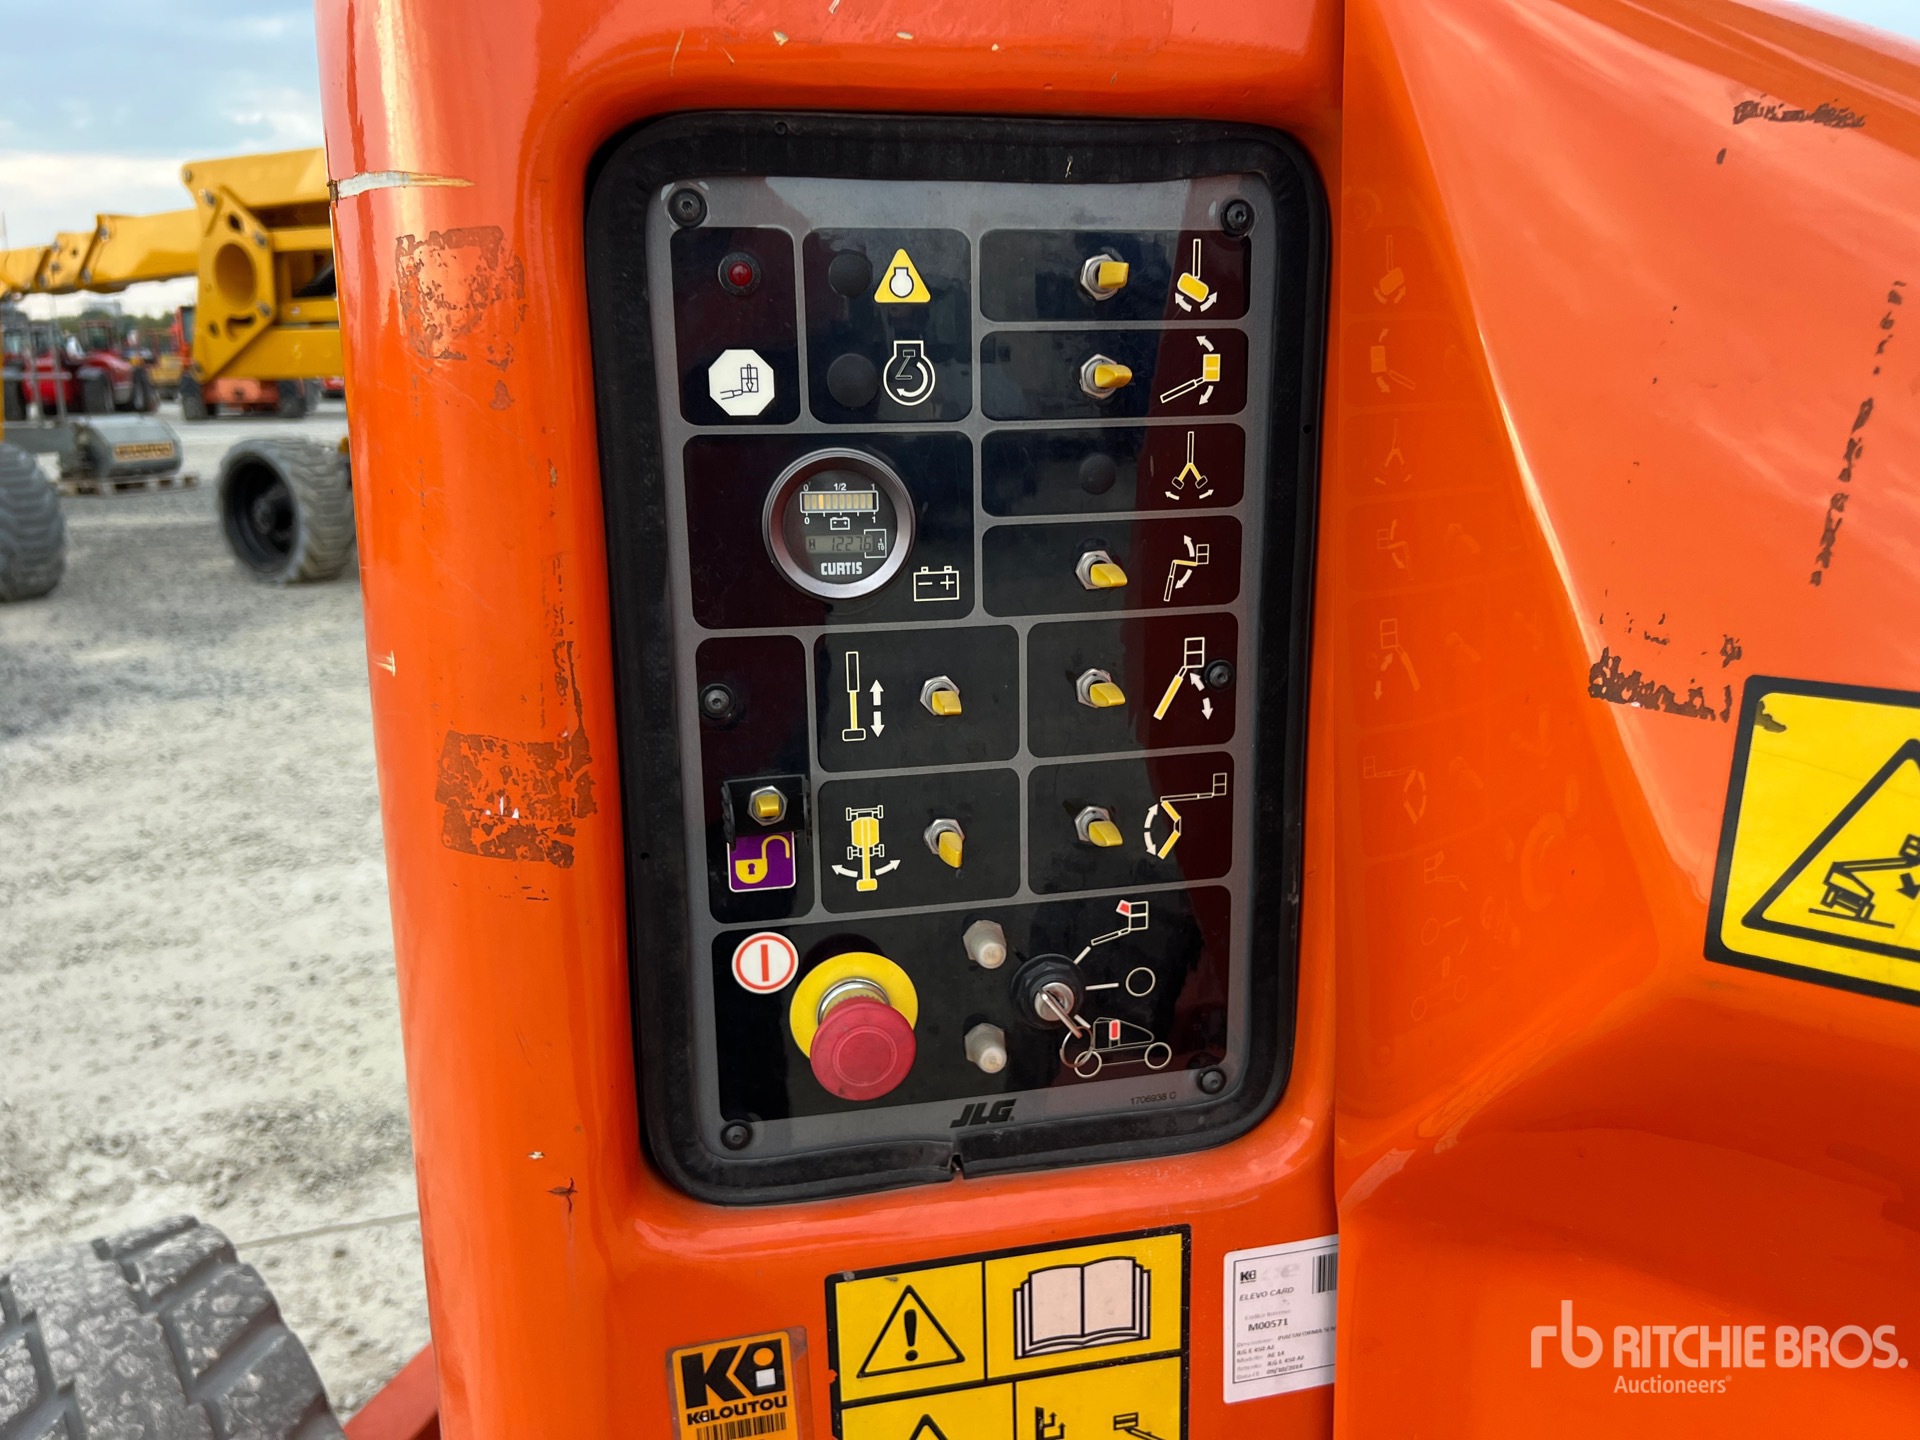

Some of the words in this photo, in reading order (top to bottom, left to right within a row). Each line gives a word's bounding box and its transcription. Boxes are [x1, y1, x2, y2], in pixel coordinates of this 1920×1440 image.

[833, 483, 847, 491] 1/2
[820, 561, 863, 576] CURTIS
[949, 1098, 1017, 1129] JLG
[1239, 1291, 1268, 1301] ELEVO
[1270, 1287, 1295, 1296] CARD
[1248, 1318, 1288, 1331] M00571
